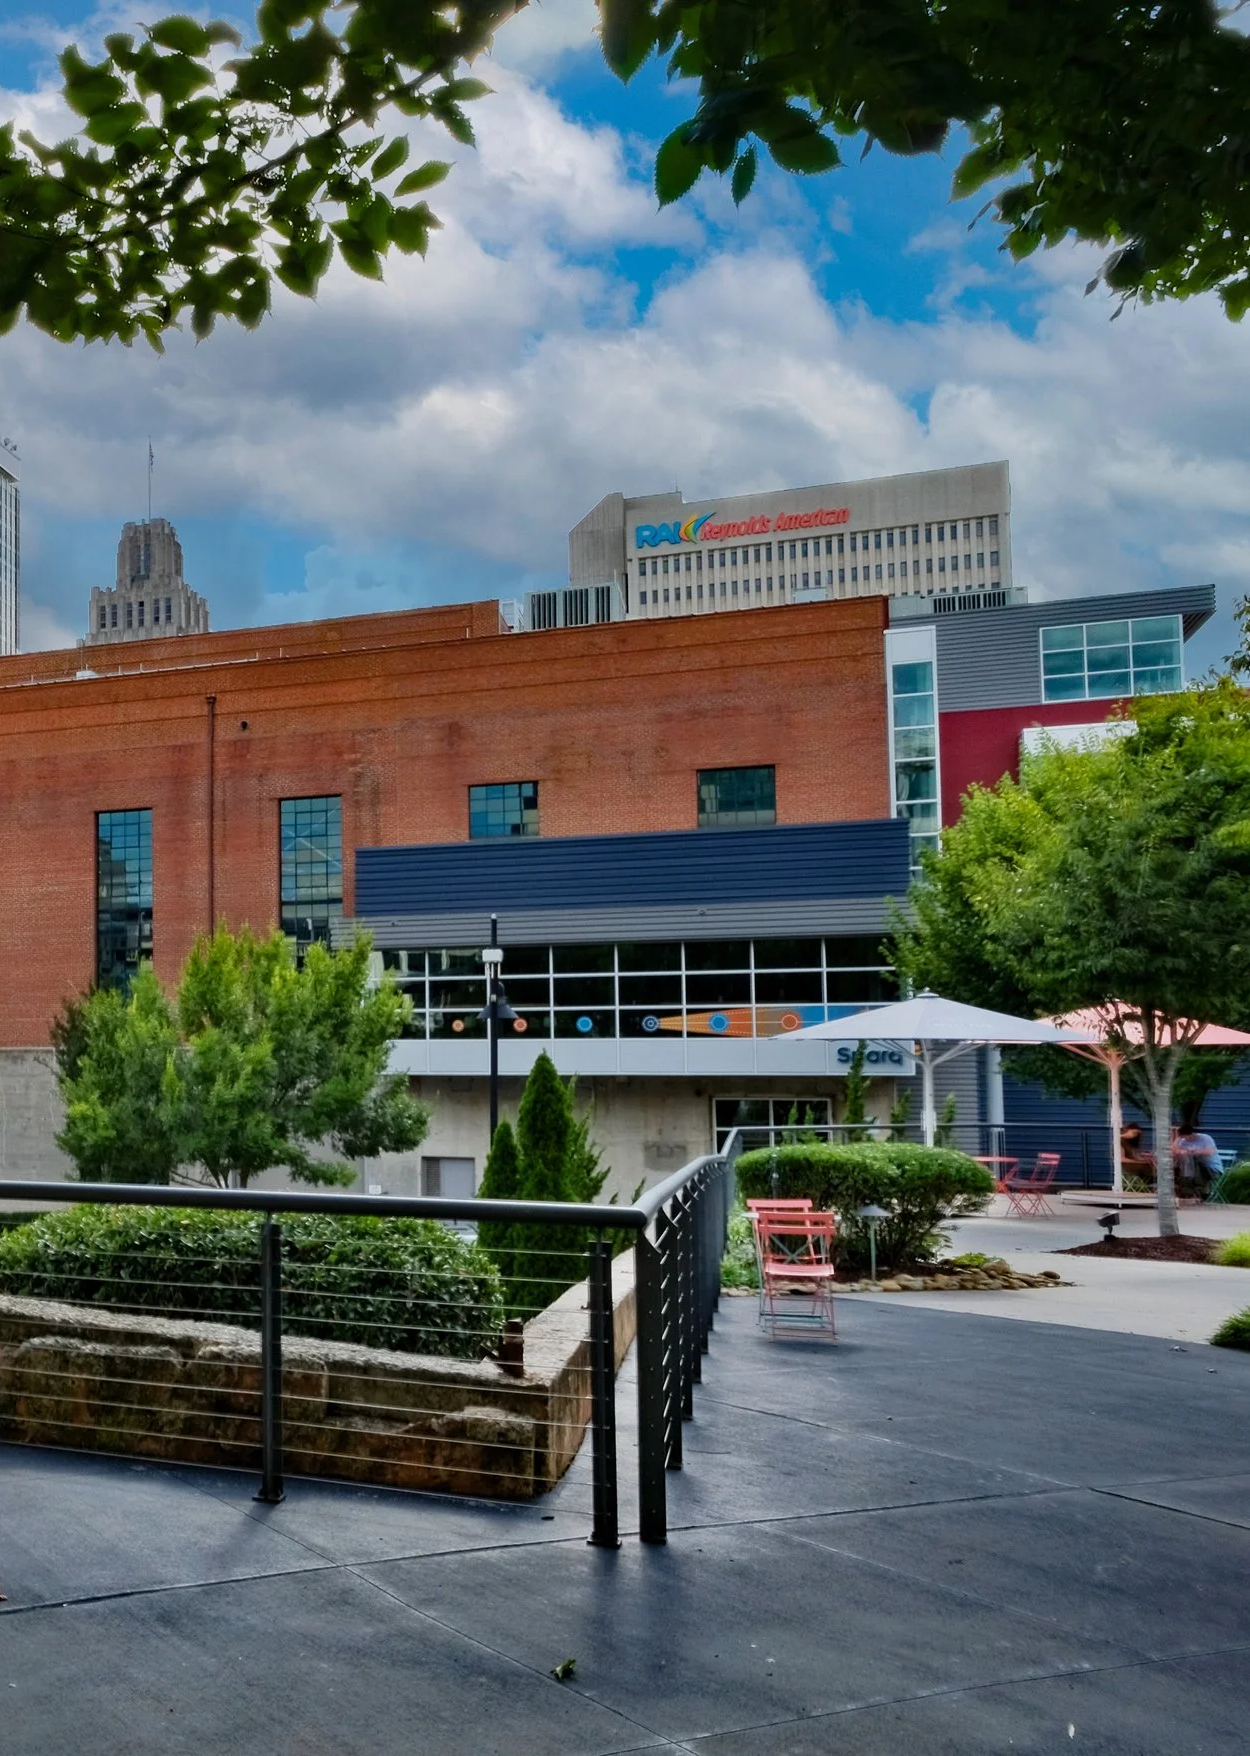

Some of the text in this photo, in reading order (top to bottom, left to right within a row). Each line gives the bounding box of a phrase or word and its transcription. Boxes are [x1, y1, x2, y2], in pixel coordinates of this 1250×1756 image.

[635, 508, 849, 549] RAI Reynolds American
